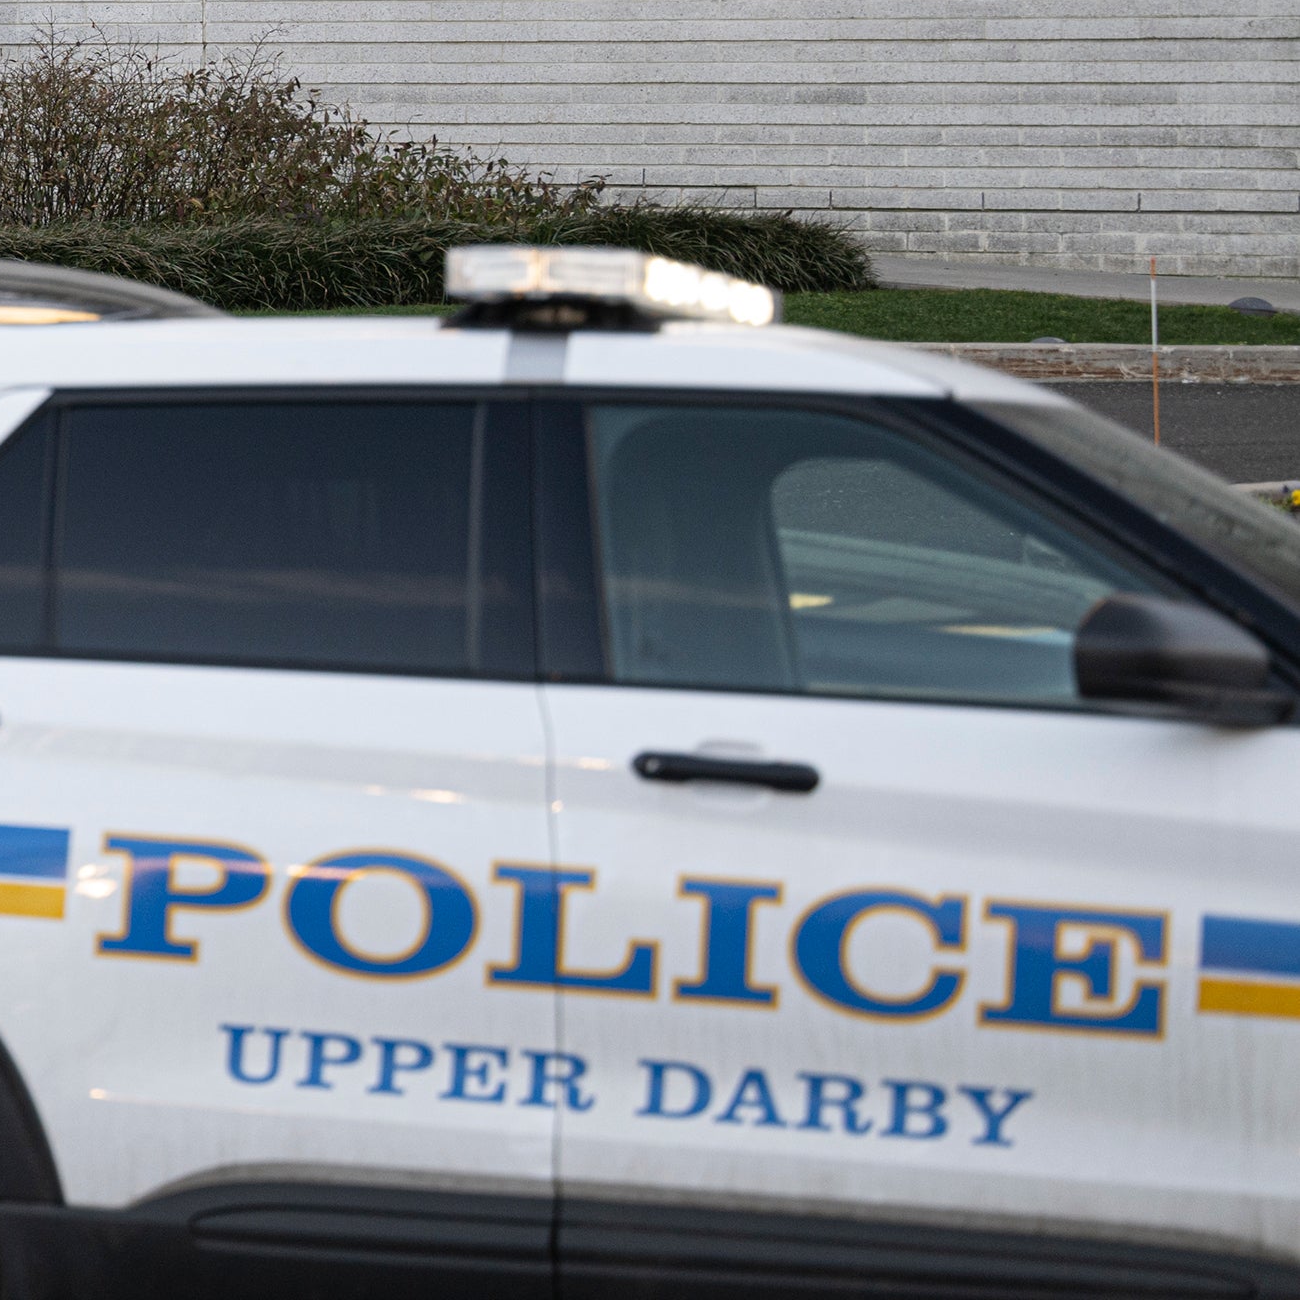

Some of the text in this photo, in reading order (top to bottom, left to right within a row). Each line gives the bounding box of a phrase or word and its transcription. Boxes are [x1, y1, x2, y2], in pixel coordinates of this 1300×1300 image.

[94, 829, 1172, 1043] POLICE
[218, 1020, 1035, 1148] UPPER DARBY
